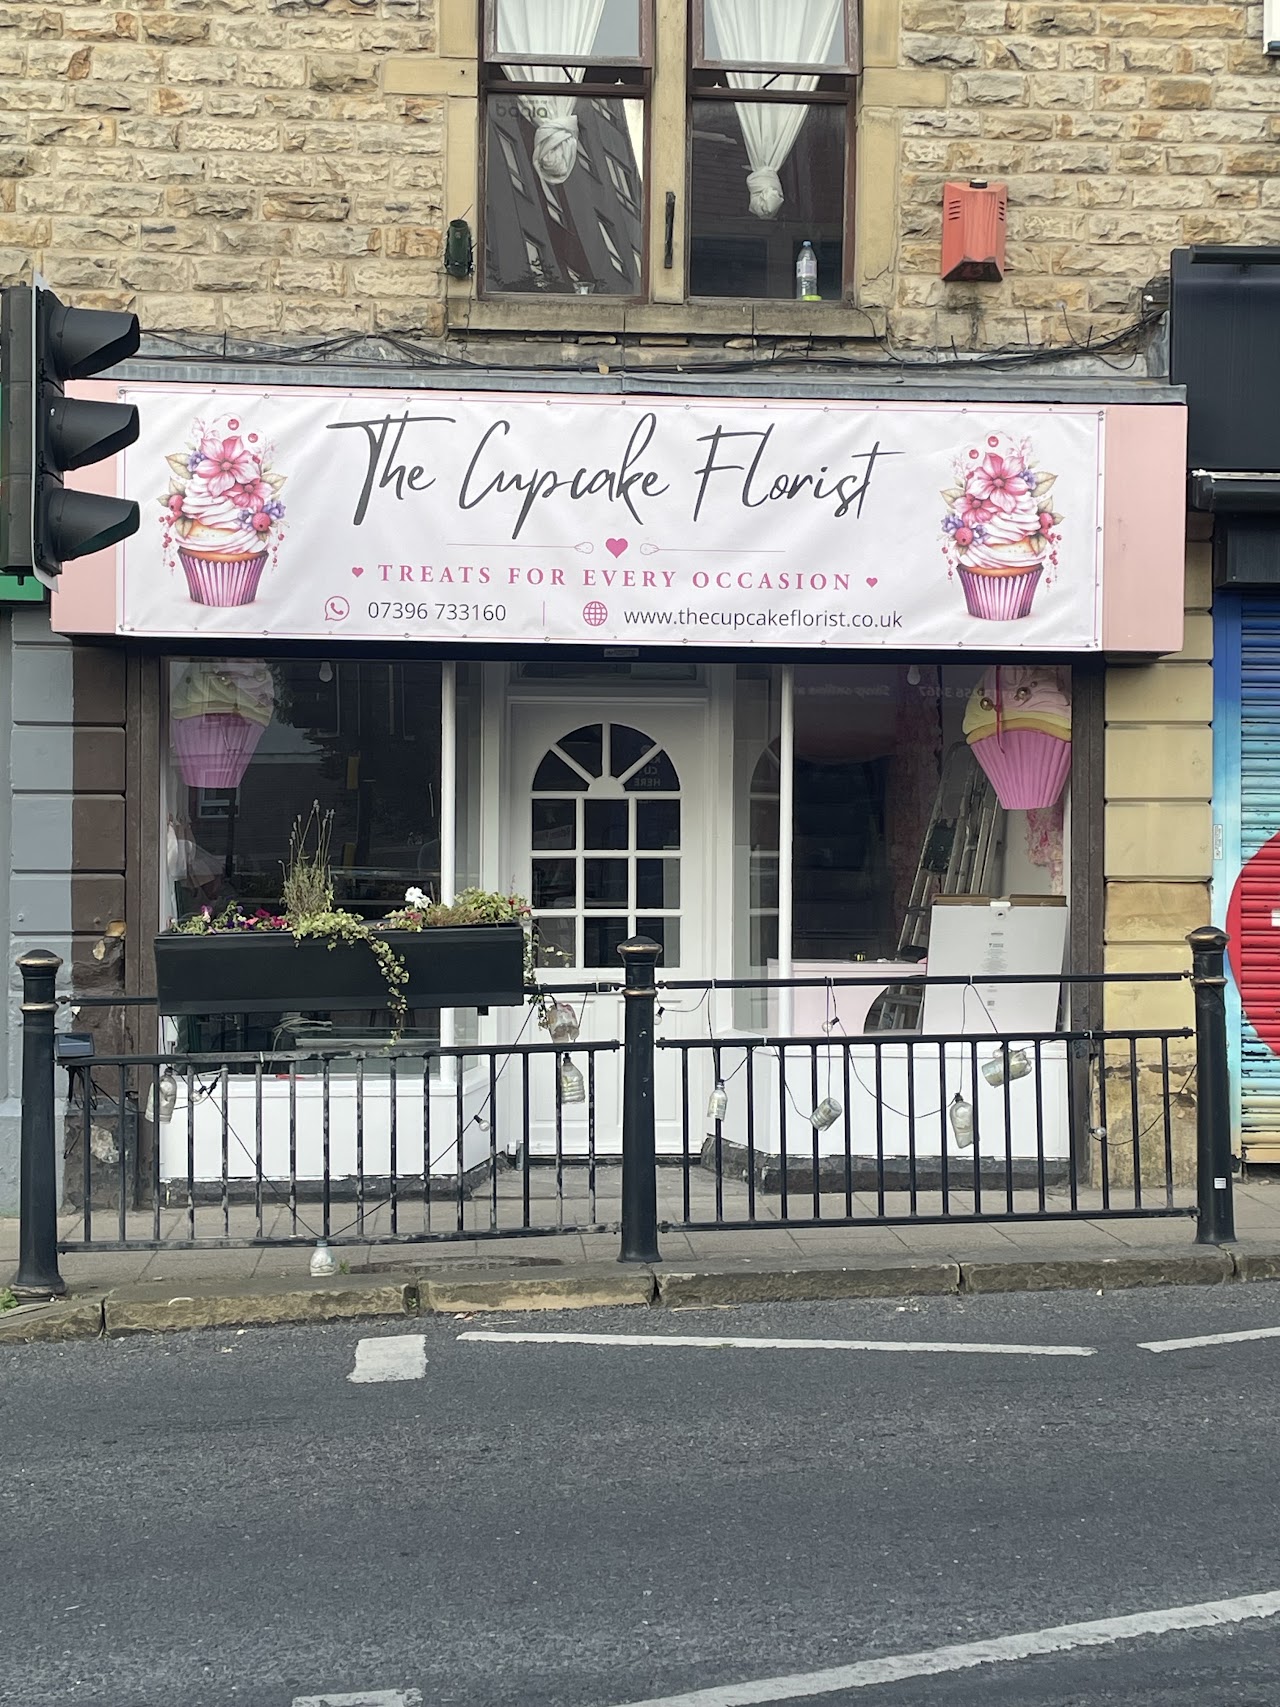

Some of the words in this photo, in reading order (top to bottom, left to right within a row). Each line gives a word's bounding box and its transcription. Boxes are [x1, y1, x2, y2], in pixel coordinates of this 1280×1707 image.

[325, 410, 457, 526] The
[458, 412, 671, 540] Cupcake
[693, 422, 906, 523] Florist
[377, 564, 490, 584] TREATS
[508, 567, 566, 586] FOR
[582, 569, 676, 588] EVERY
[692, 571, 850, 591] OCCASION
[367, 601, 428, 620] 07396
[434, 603, 507, 622] 733160
[623, 607, 903, 631] www.thecupcakeflorist.co.uk
